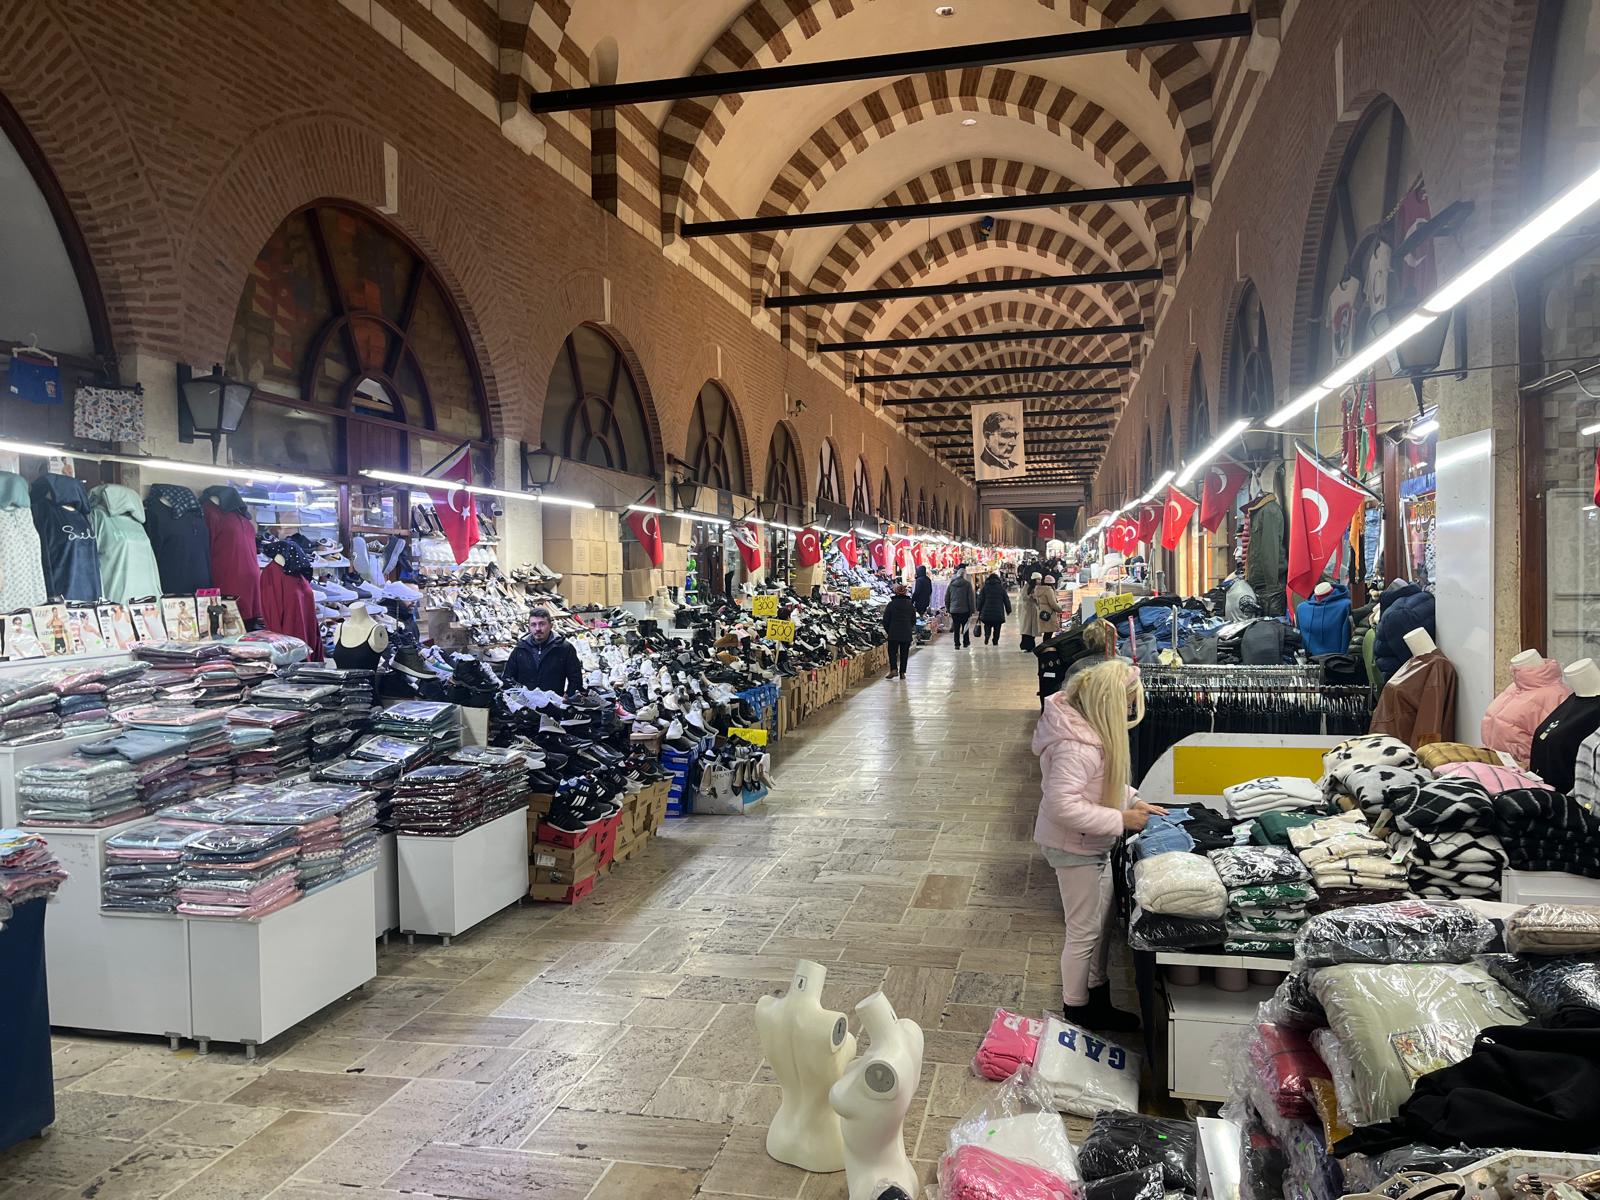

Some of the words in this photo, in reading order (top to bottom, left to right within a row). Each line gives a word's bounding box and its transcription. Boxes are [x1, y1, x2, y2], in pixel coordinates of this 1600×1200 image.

[758, 601, 774, 610] 300
[1098, 597, 1121, 607] SPOR
[770, 623, 792, 637] 500
[1058, 1028, 1126, 1070] GAP
